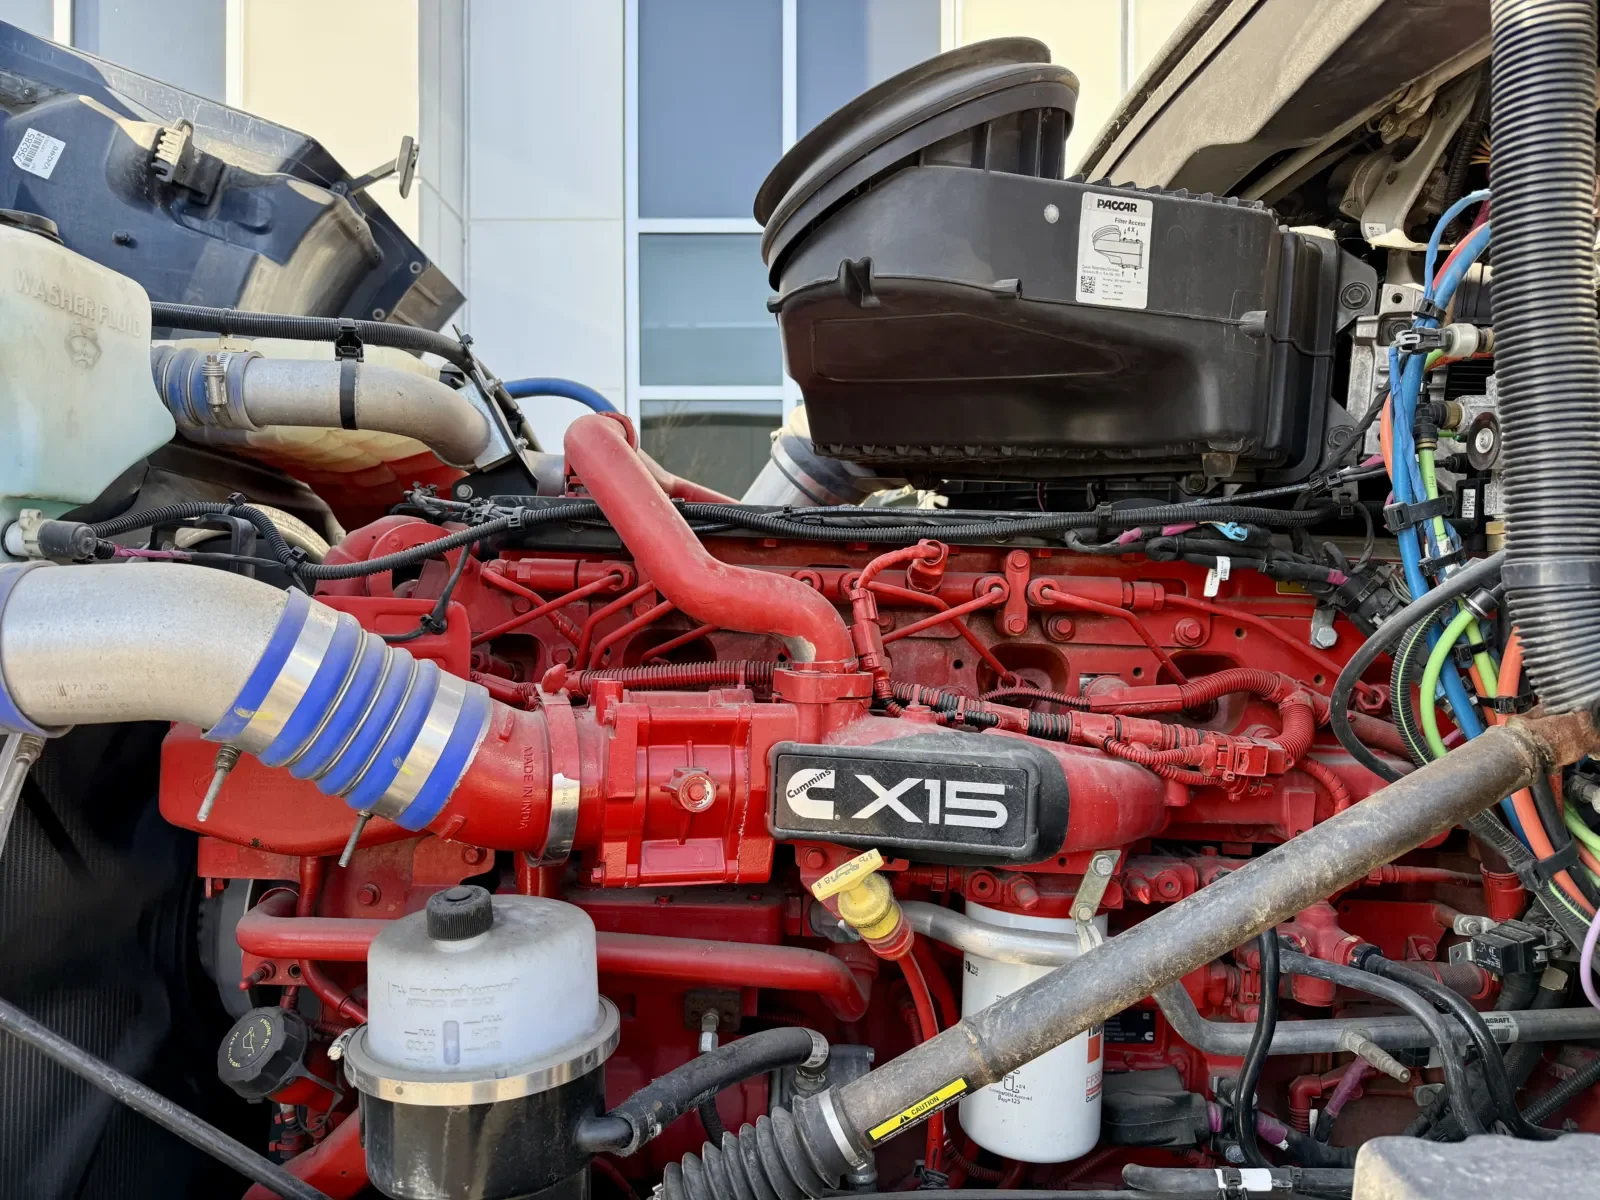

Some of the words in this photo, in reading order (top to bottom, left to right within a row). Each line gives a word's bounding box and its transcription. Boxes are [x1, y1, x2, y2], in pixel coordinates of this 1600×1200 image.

[14, 132, 35, 162] 756285
[1097, 199, 1137, 213] PACCAR
[1115, 217, 1128, 225] Filter
[1128, 219, 1146, 227] Access
[16, 267, 95, 321] WASHER
[99, 302, 142, 338] FLUID
[523, 745, 534, 782] MADE
[522, 785, 534, 800] IN
[786, 768, 832, 799] Cummins
[851, 774, 1008, 829] X15
[518, 801, 532, 830] INDIA
[260, 1018, 272, 1037] ENGINE
[261, 1038, 270, 1050] OIL
[911, 1096, 940, 1115] CAUTION
